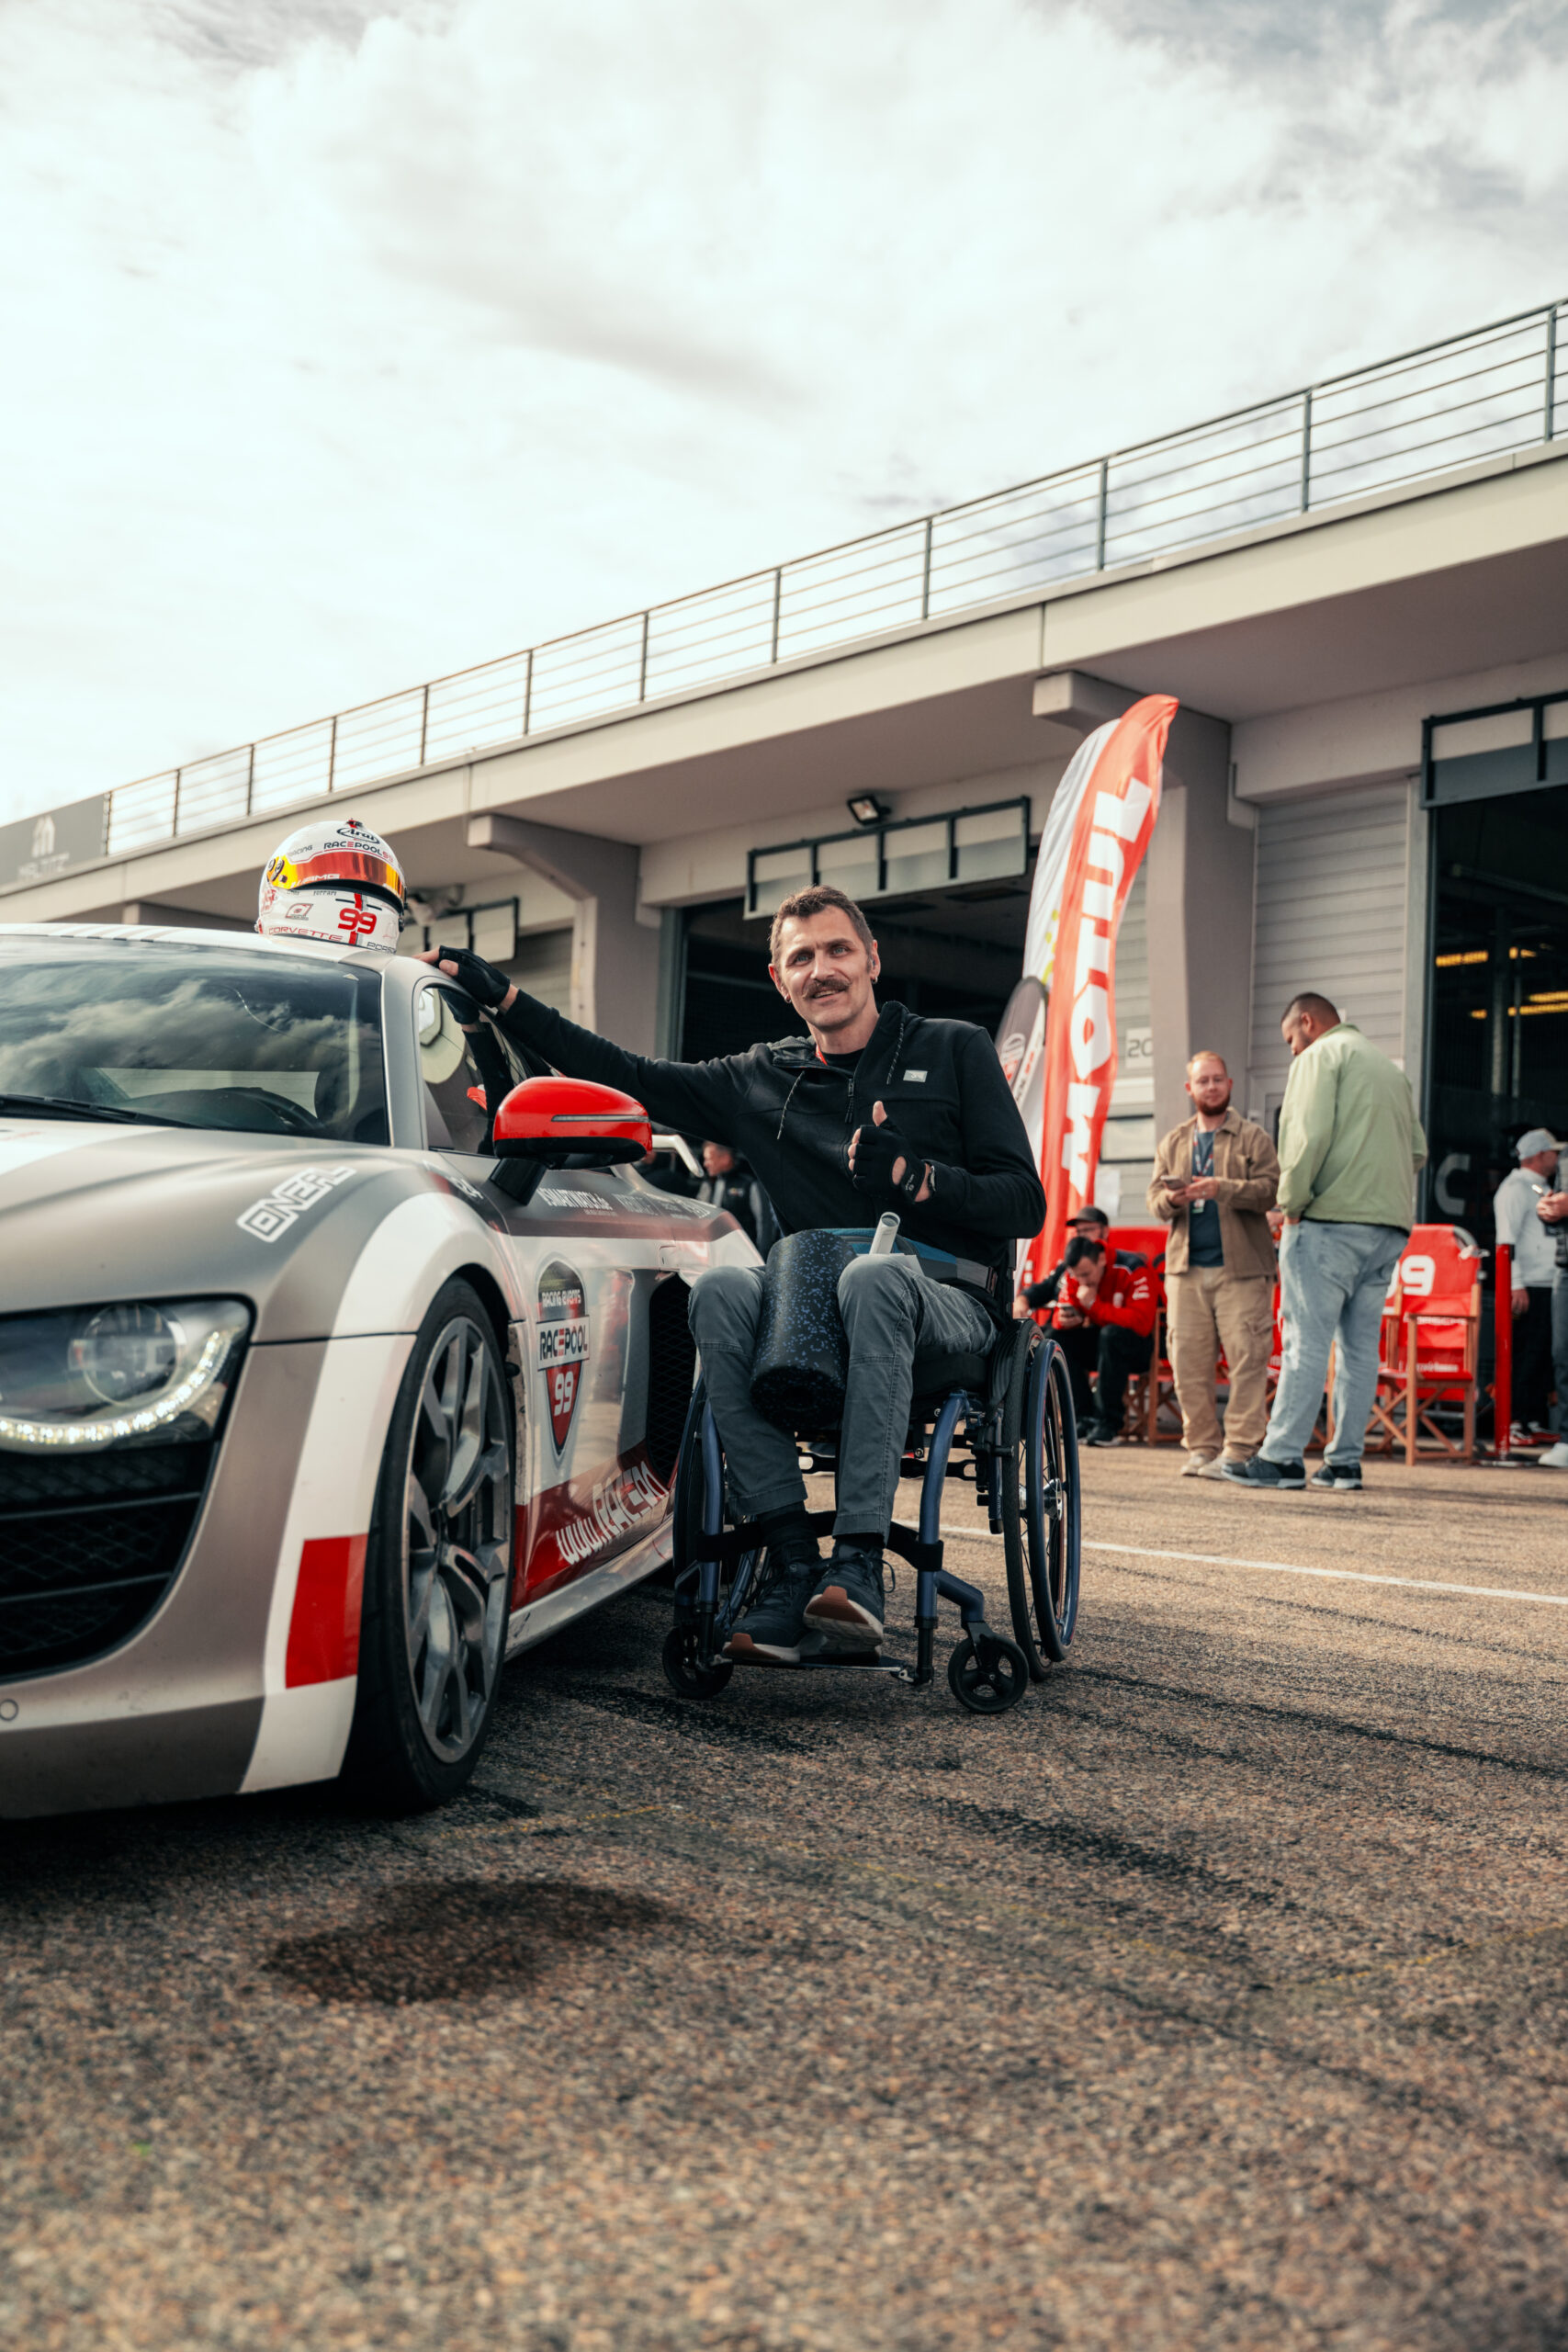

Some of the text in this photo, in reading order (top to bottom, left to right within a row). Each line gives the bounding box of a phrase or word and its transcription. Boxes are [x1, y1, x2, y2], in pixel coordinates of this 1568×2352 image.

[269, 926, 344, 942] CORVETTE
[338, 907, 377, 934] 99
[1061, 776, 1152, 1197] MOTUL
[539, 1325, 588, 1361] RACEPOOL
[554, 1371, 574, 1417] 99
